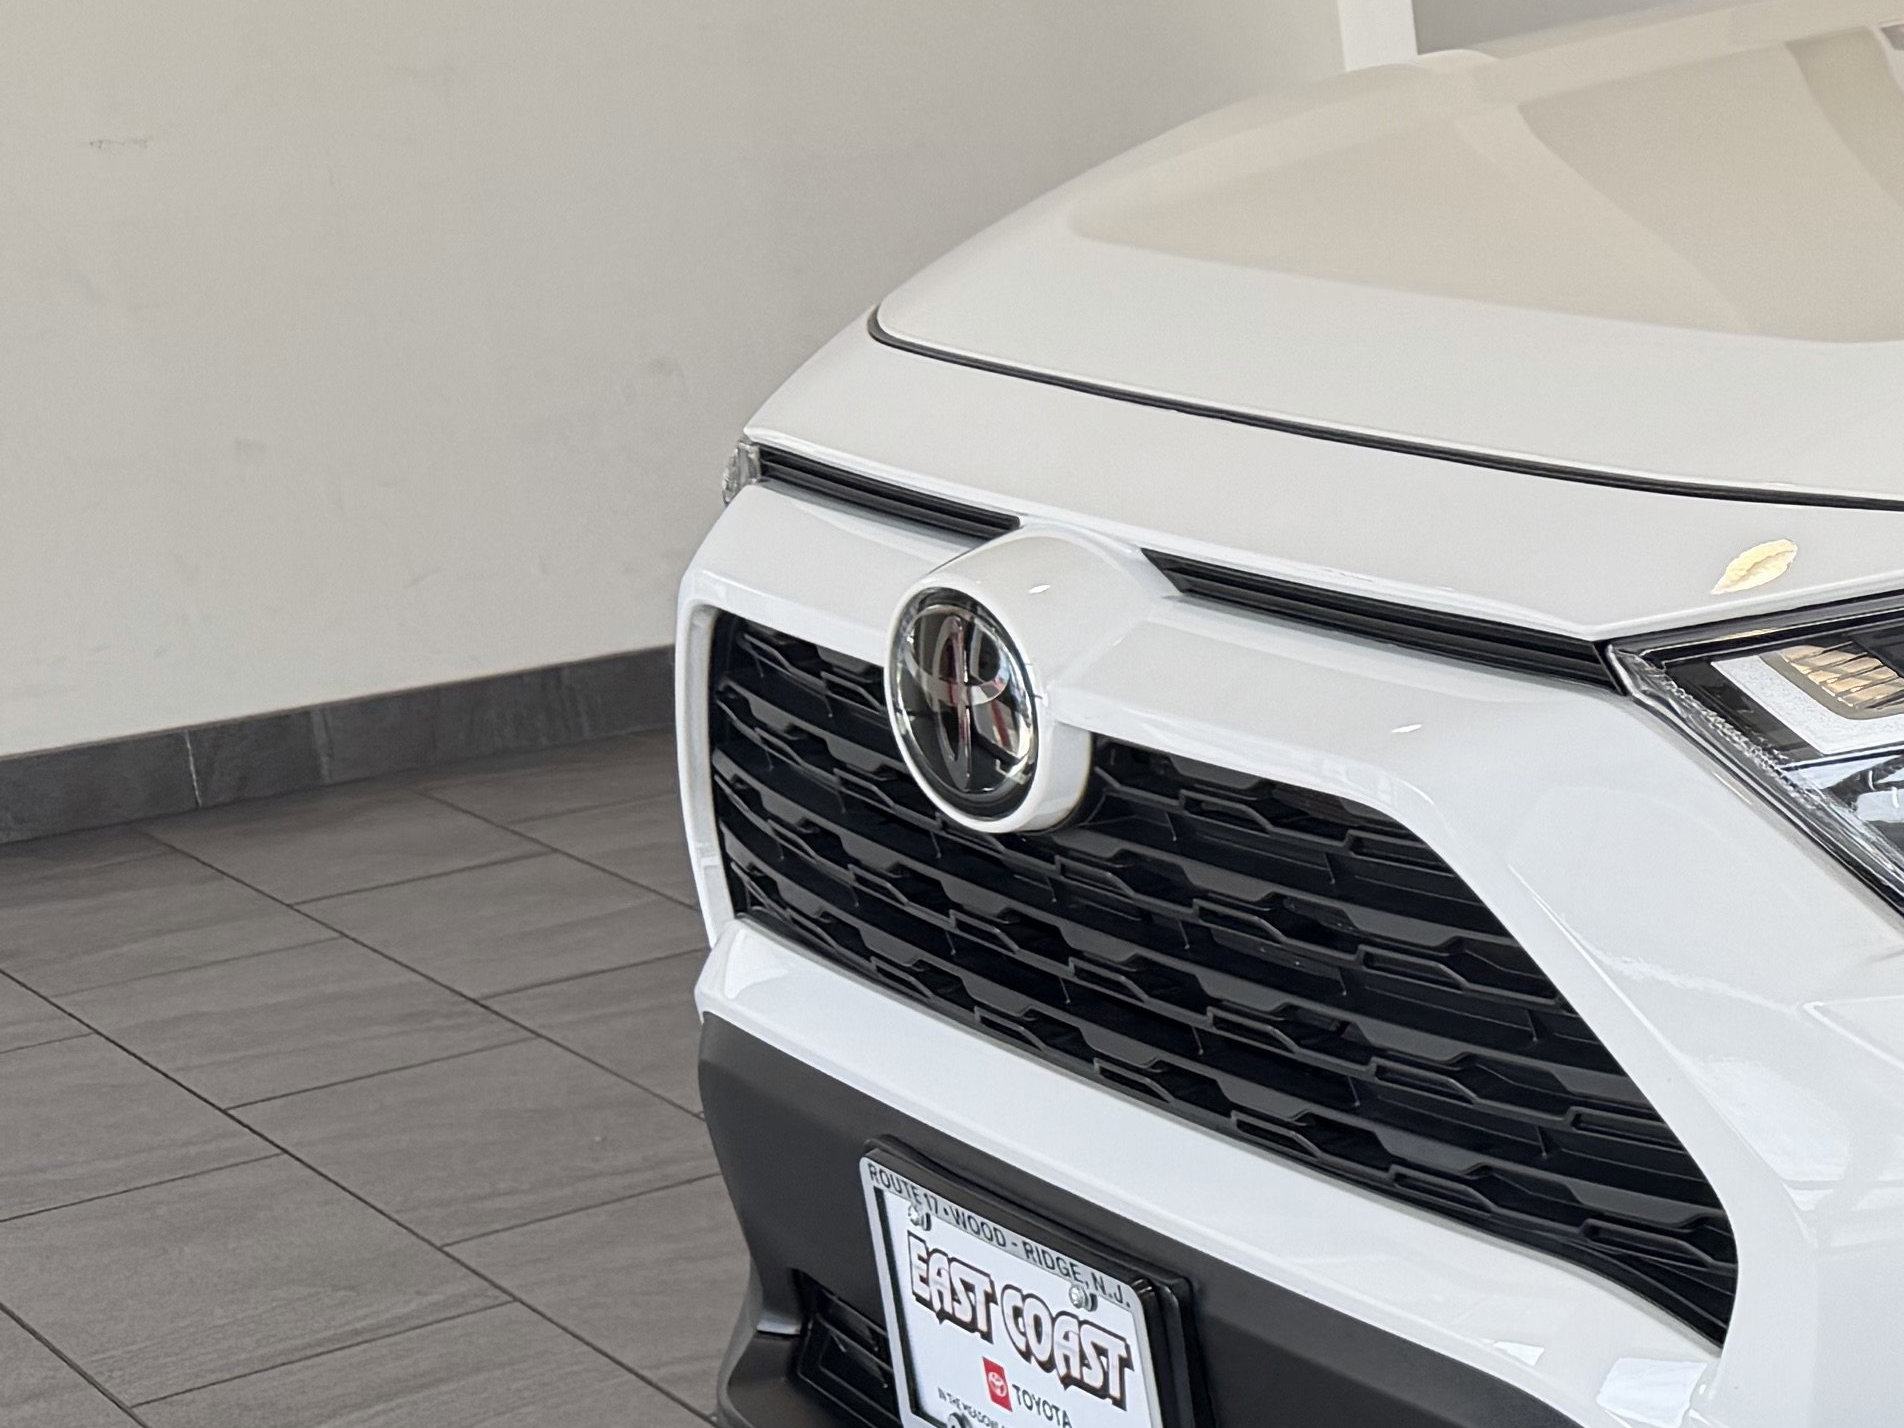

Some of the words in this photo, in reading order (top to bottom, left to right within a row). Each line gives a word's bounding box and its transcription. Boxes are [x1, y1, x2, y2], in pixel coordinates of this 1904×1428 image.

[867, 1162, 922, 1205] ROUTE
[923, 1194, 940, 1215] 17
[950, 1204, 1007, 1248] WOOD
[1022, 1240, 1089, 1290] RIDGE,
[1093, 1272, 1132, 1308] N.J.
[907, 1229, 998, 1344] EAST
[1000, 1282, 1135, 1411] COAST
